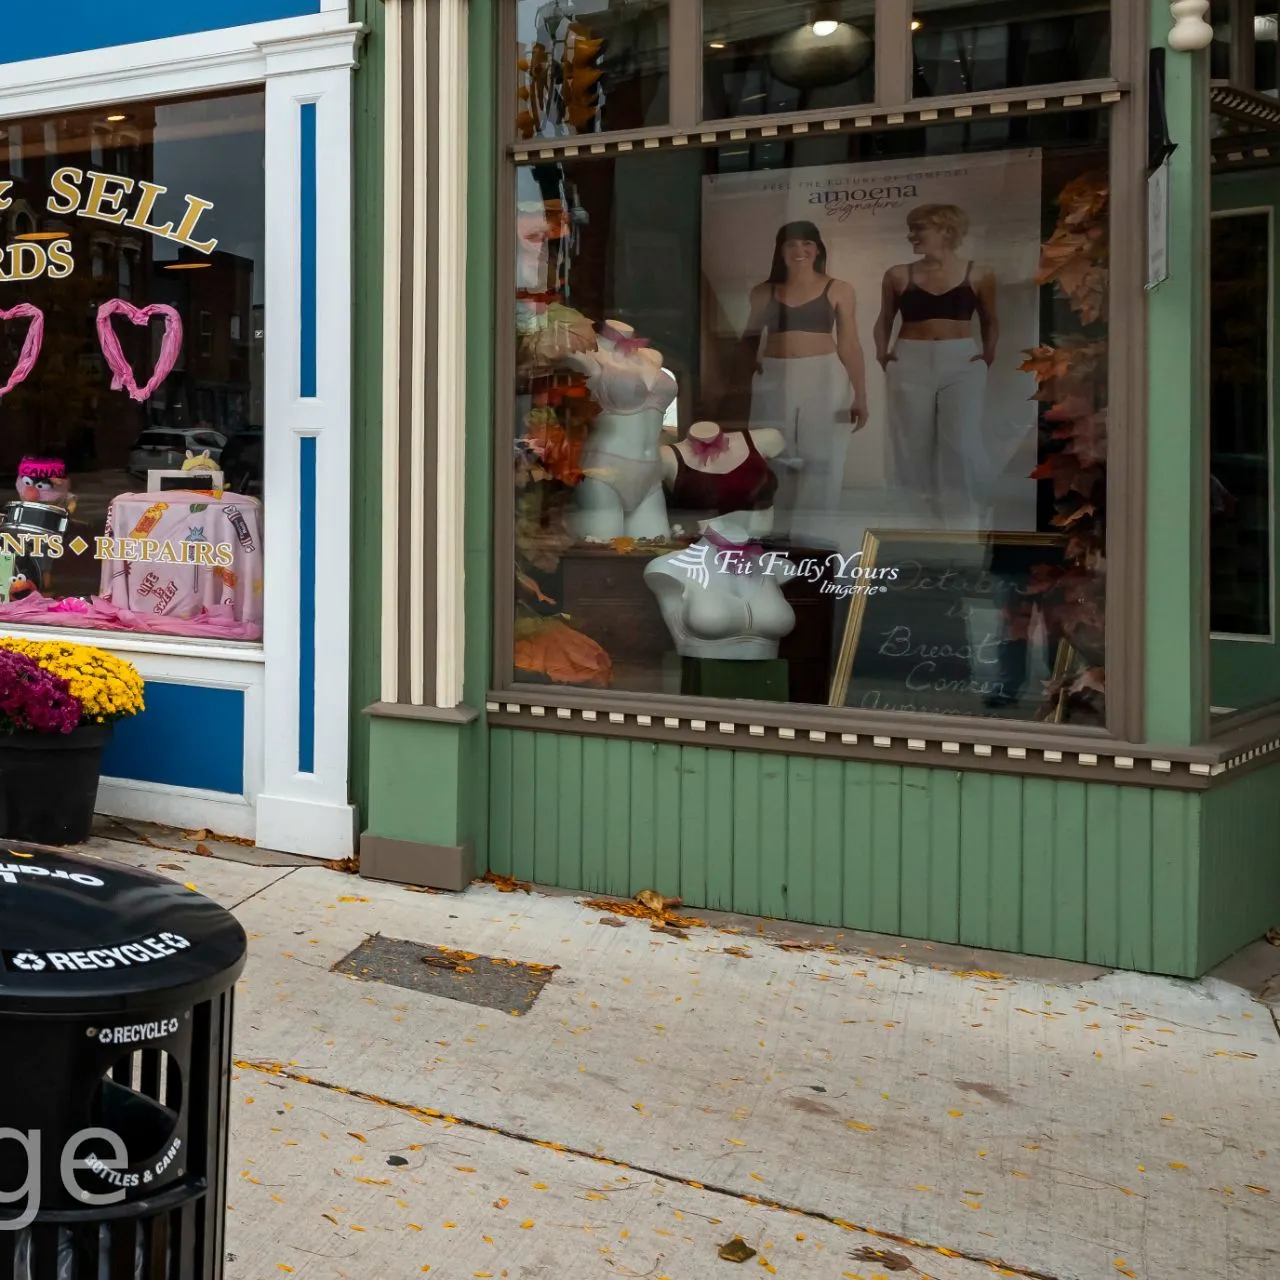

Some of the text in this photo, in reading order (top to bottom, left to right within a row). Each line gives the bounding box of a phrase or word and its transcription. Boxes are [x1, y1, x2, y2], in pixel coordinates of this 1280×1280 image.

[46, 166, 218, 254] SELL
[808, 184, 918, 205] amoena
[824, 198, 908, 222] Signature
[94, 536, 234, 567] REPAIRS
[714, 550, 900, 583] Fit Fully Yours
[137, 572, 159, 597] LIFE
[153, 581, 178, 616] SWEET
[878, 626, 1004, 664] Breast
[905, 660, 1011, 698] Cancer
[46, 939, 171, 971] RECYCLE
[113, 1019, 169, 1044] RECYCLE
[84, 1137, 182, 1187] BOTTLES & CANS
